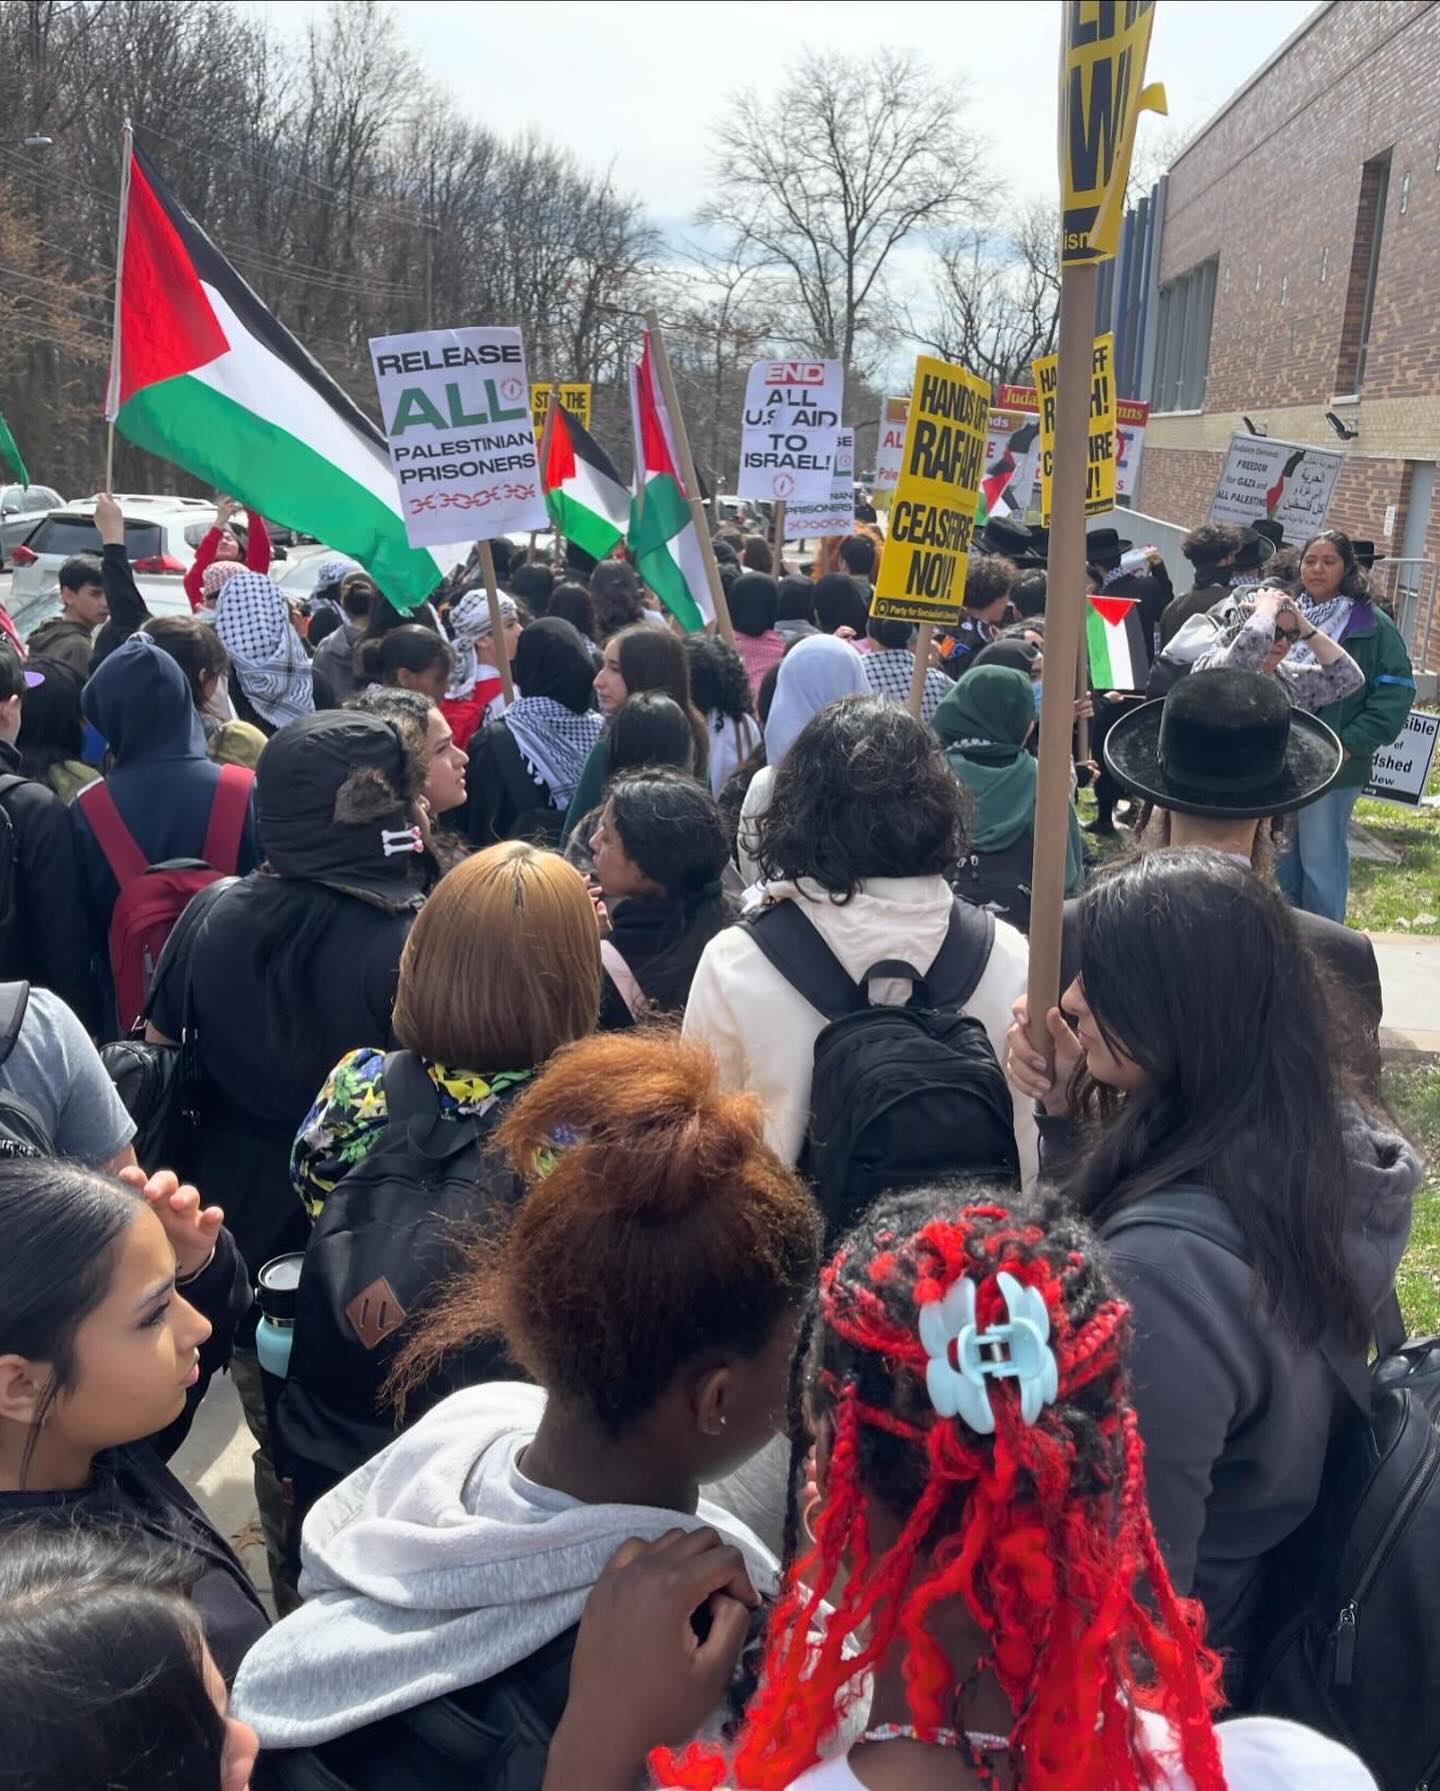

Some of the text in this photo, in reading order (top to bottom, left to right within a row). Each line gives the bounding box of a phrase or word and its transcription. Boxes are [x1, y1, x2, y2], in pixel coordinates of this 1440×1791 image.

[377, 345, 522, 377] RELEASE
[768, 363, 824, 383] END
[390, 379, 527, 436] ALL
[565, 391, 586, 409] THE
[767, 389, 817, 407] ALL
[394, 431, 533, 462] PALESTINIAN
[769, 434, 807, 451] TO
[400, 453, 536, 485] PRISONERS
[744, 453, 831, 470] ISRAEL!
